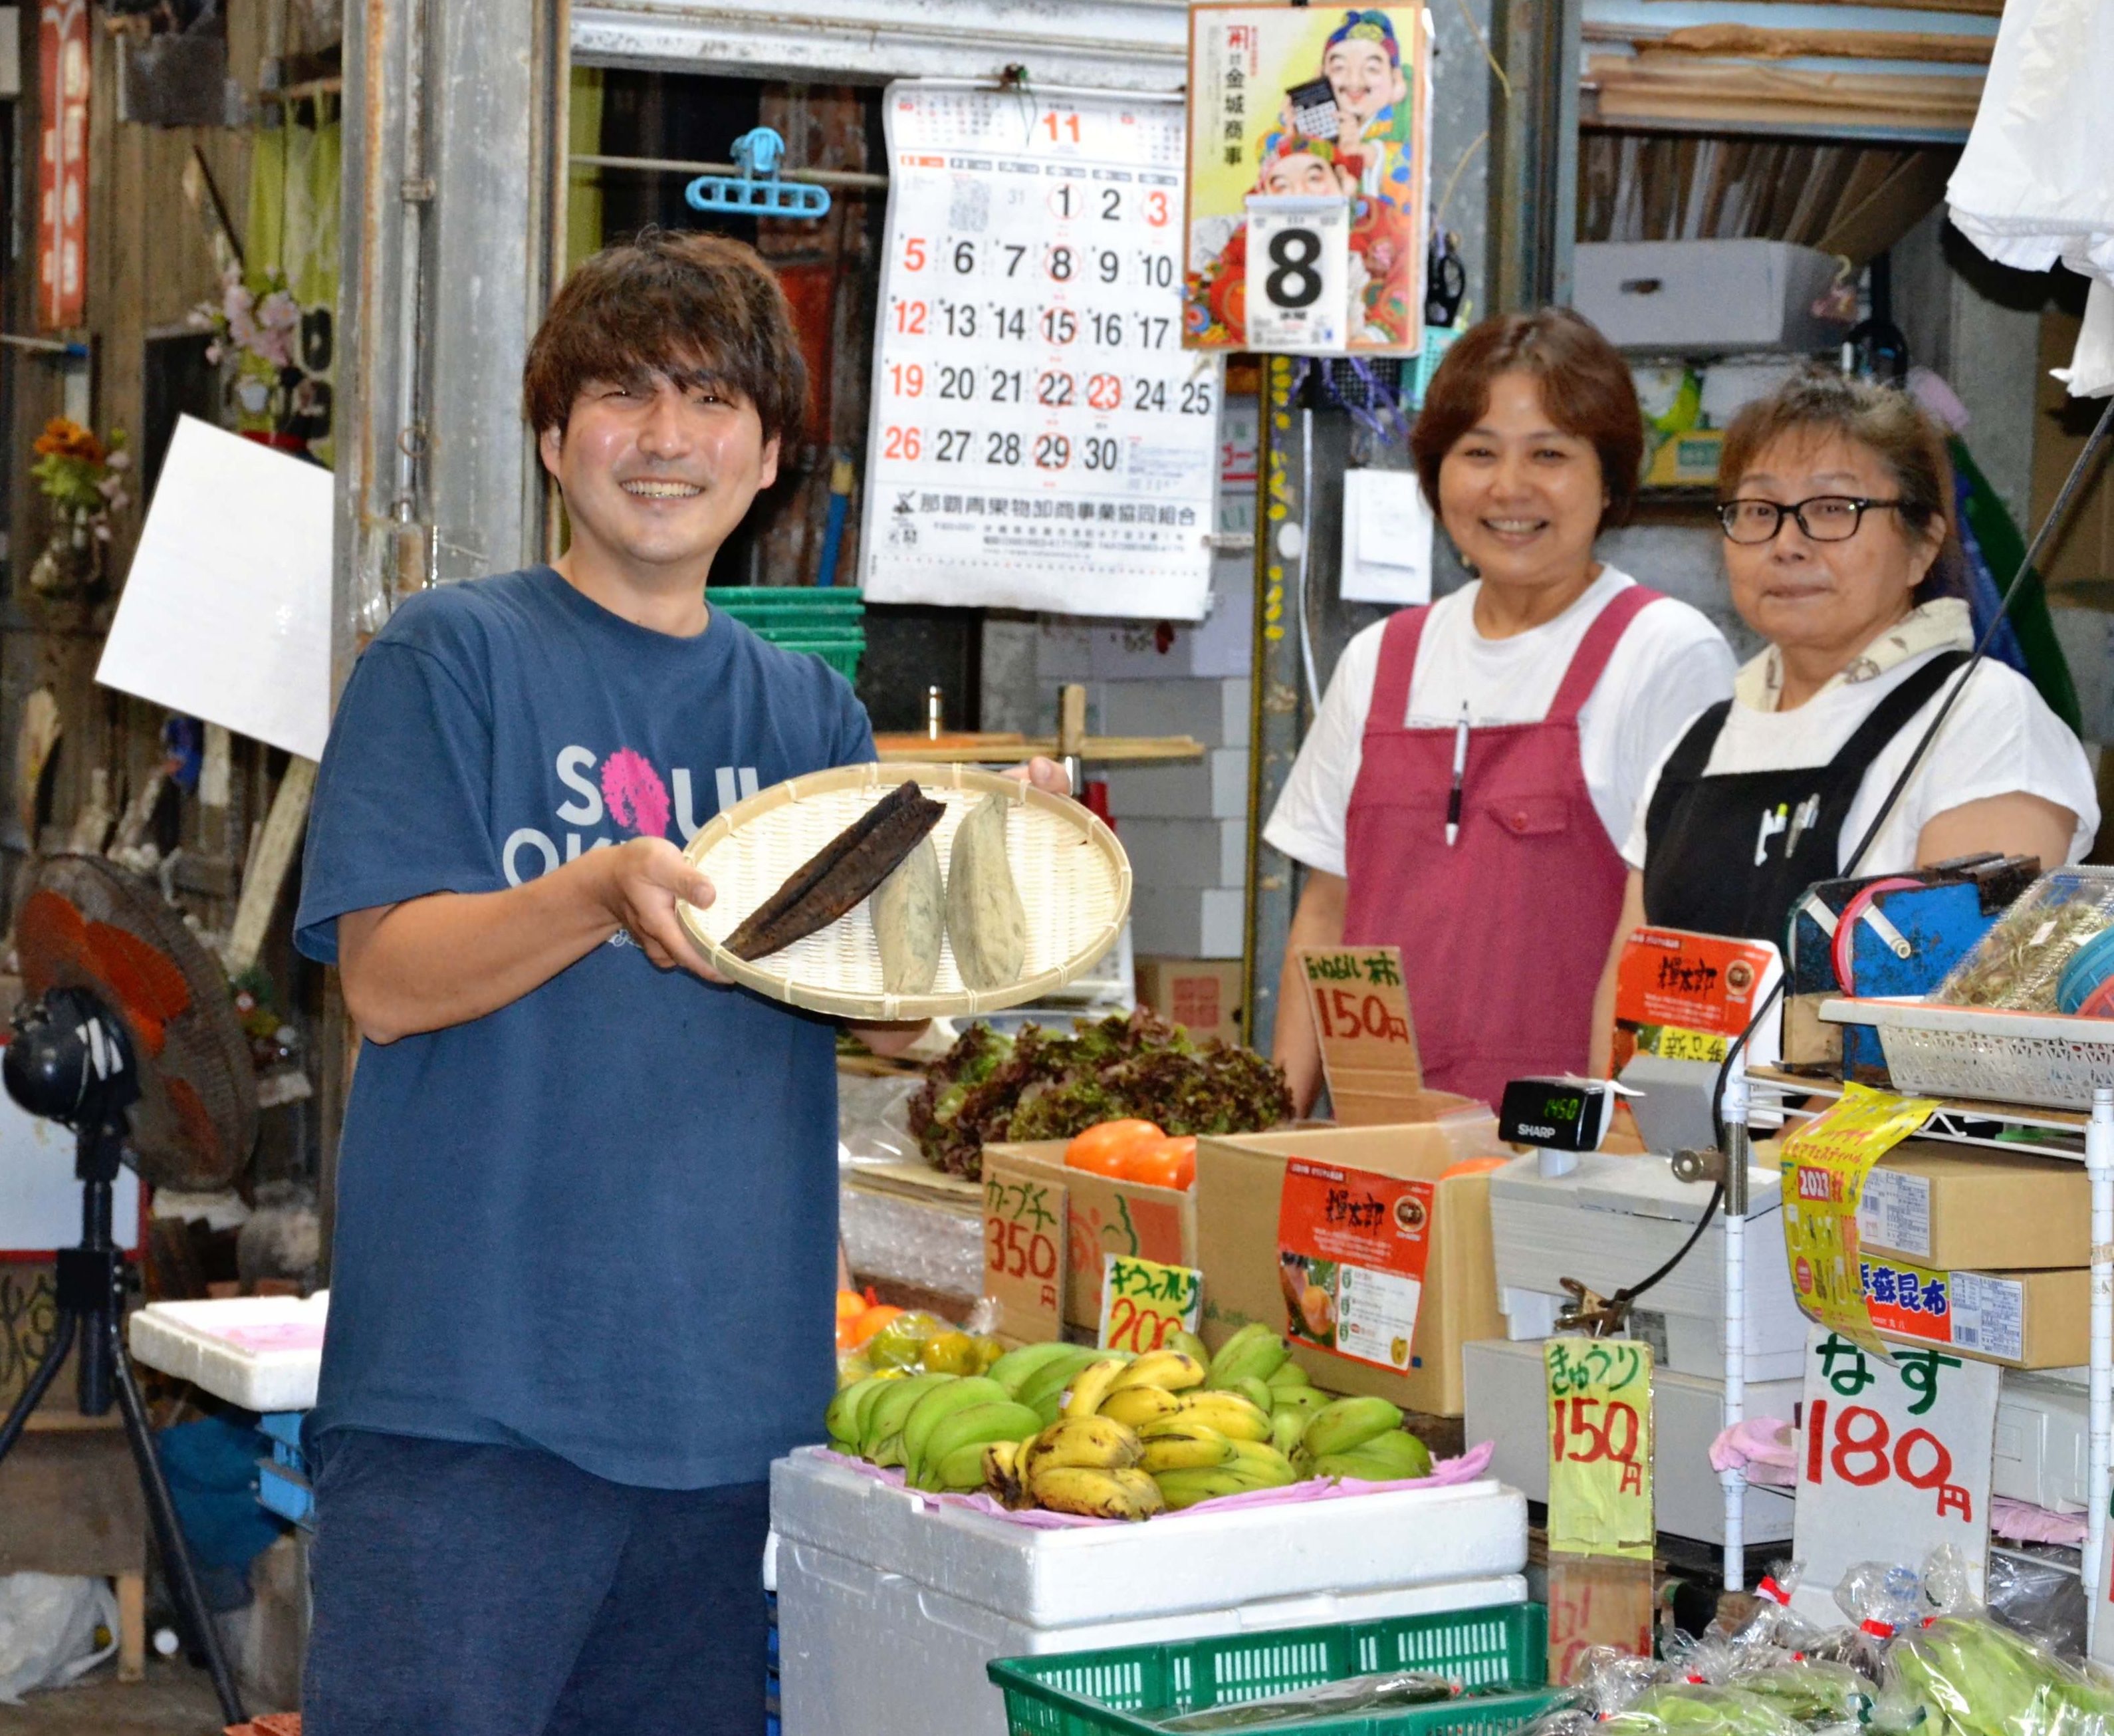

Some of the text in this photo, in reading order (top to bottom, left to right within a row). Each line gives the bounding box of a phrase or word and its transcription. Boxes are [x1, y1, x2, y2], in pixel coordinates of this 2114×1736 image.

[1043, 112, 1080, 142] 11
[1059, 184, 1070, 218] 1
[1102, 190, 1120, 220] 2
[1149, 192, 1167, 226] 3
[904, 238, 1171, 287] 5 6 7 8 9 10
[1266, 229, 1322, 308] 8
[895, 301, 1168, 348] 12 13 14 15 16 17
[890, 364, 1210, 415] 19 20 21 22 23 24 25
[884, 426, 920, 459] 26
[937, 430, 971, 462] 27
[987, 433, 1020, 465] 28
[1036, 436, 1069, 468] 29
[1085, 438, 1117, 470] 30
[1517, 1123, 1556, 1139] SHARP
[1799, 1170, 1829, 1197] 2023
[1550, 1344, 1639, 1396] きゅうり
[1816, 1332, 1962, 1414] なす
